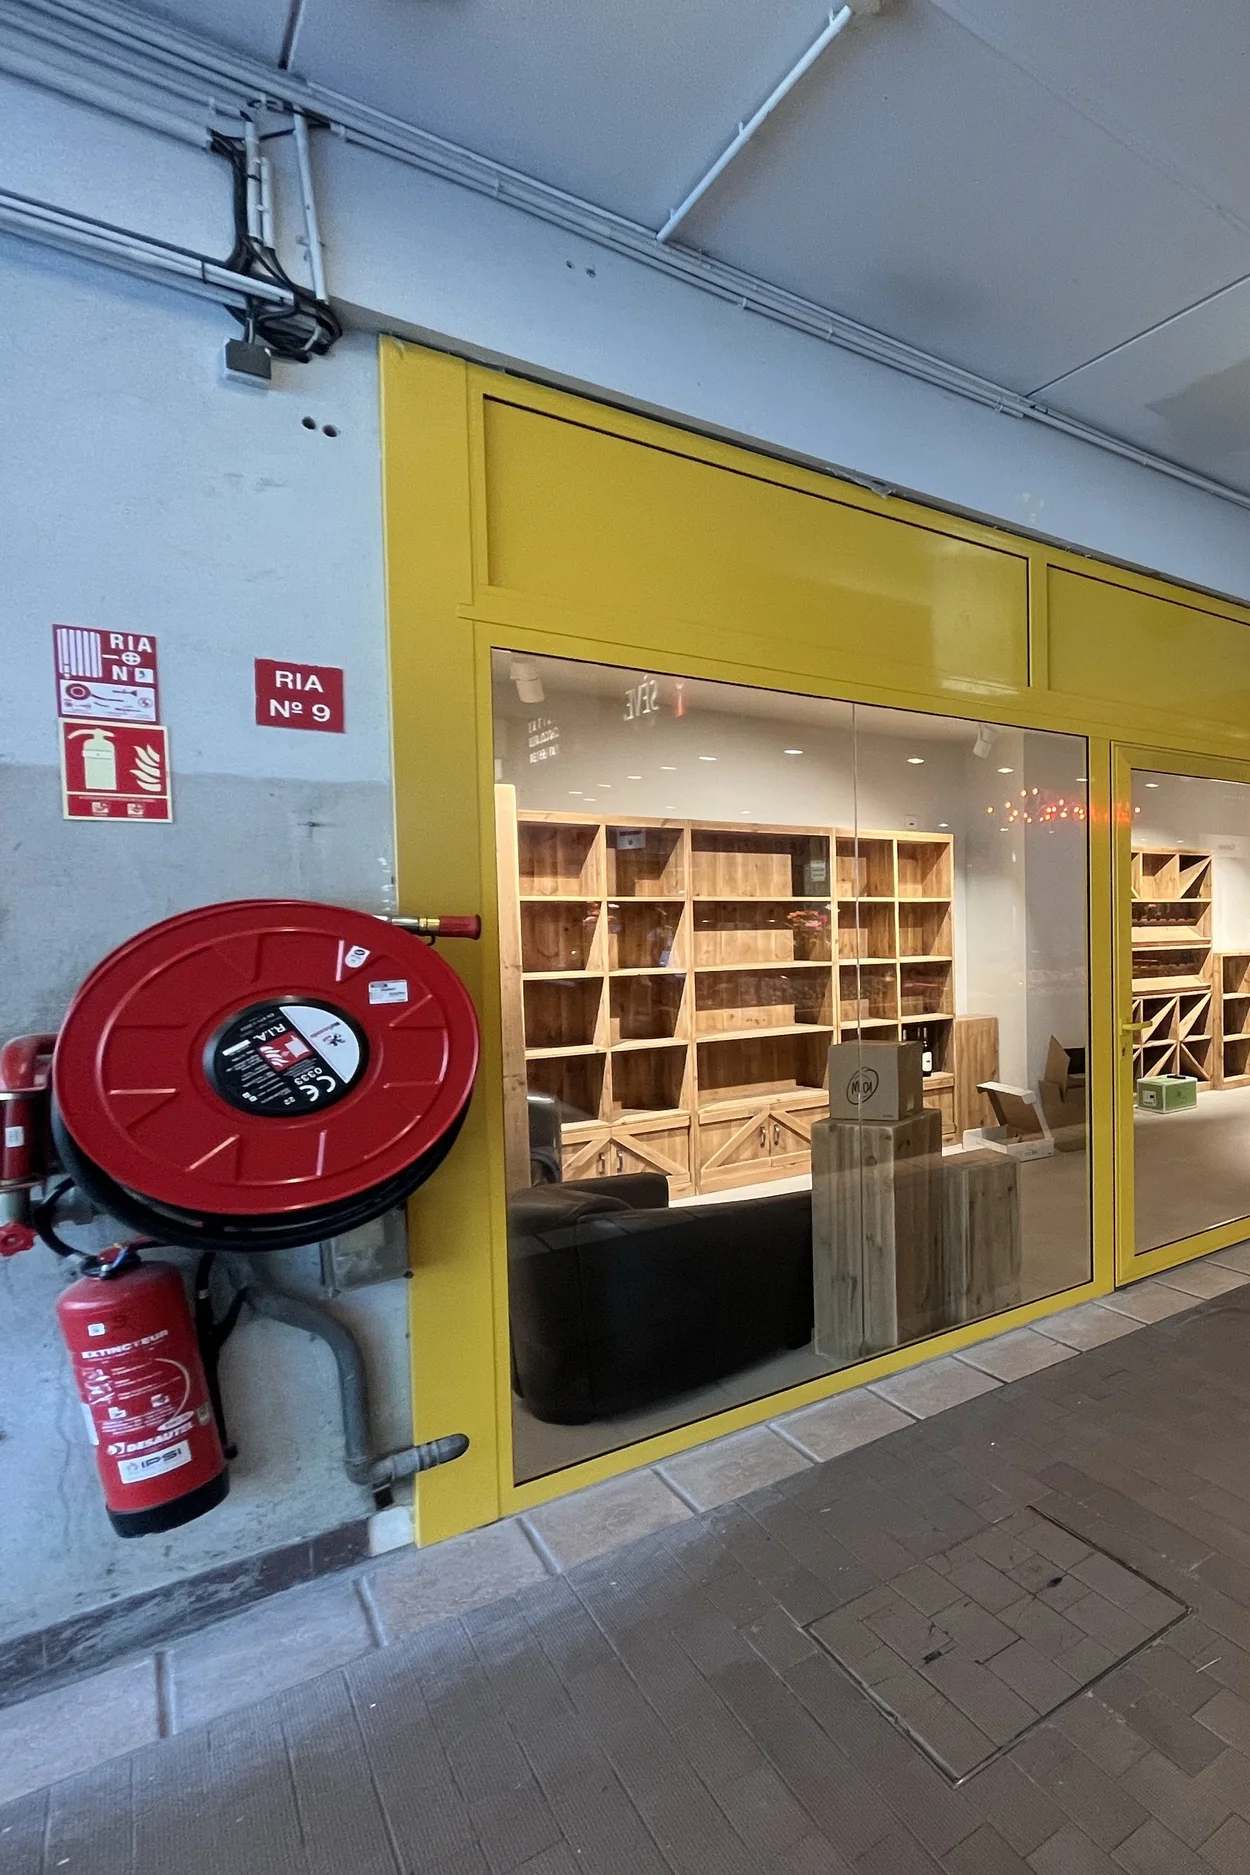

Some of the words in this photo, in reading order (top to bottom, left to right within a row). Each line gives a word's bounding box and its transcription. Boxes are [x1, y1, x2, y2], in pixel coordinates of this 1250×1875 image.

[110, 633, 152, 653] RIA
[274, 669, 324, 693] RIA
[312, 703, 331, 722] 9
[253, 1023, 286, 1044] R.I.A.
[82, 1329, 169, 1359] EXTINCTEUR
[141, 1448, 183, 1469] IPSI
